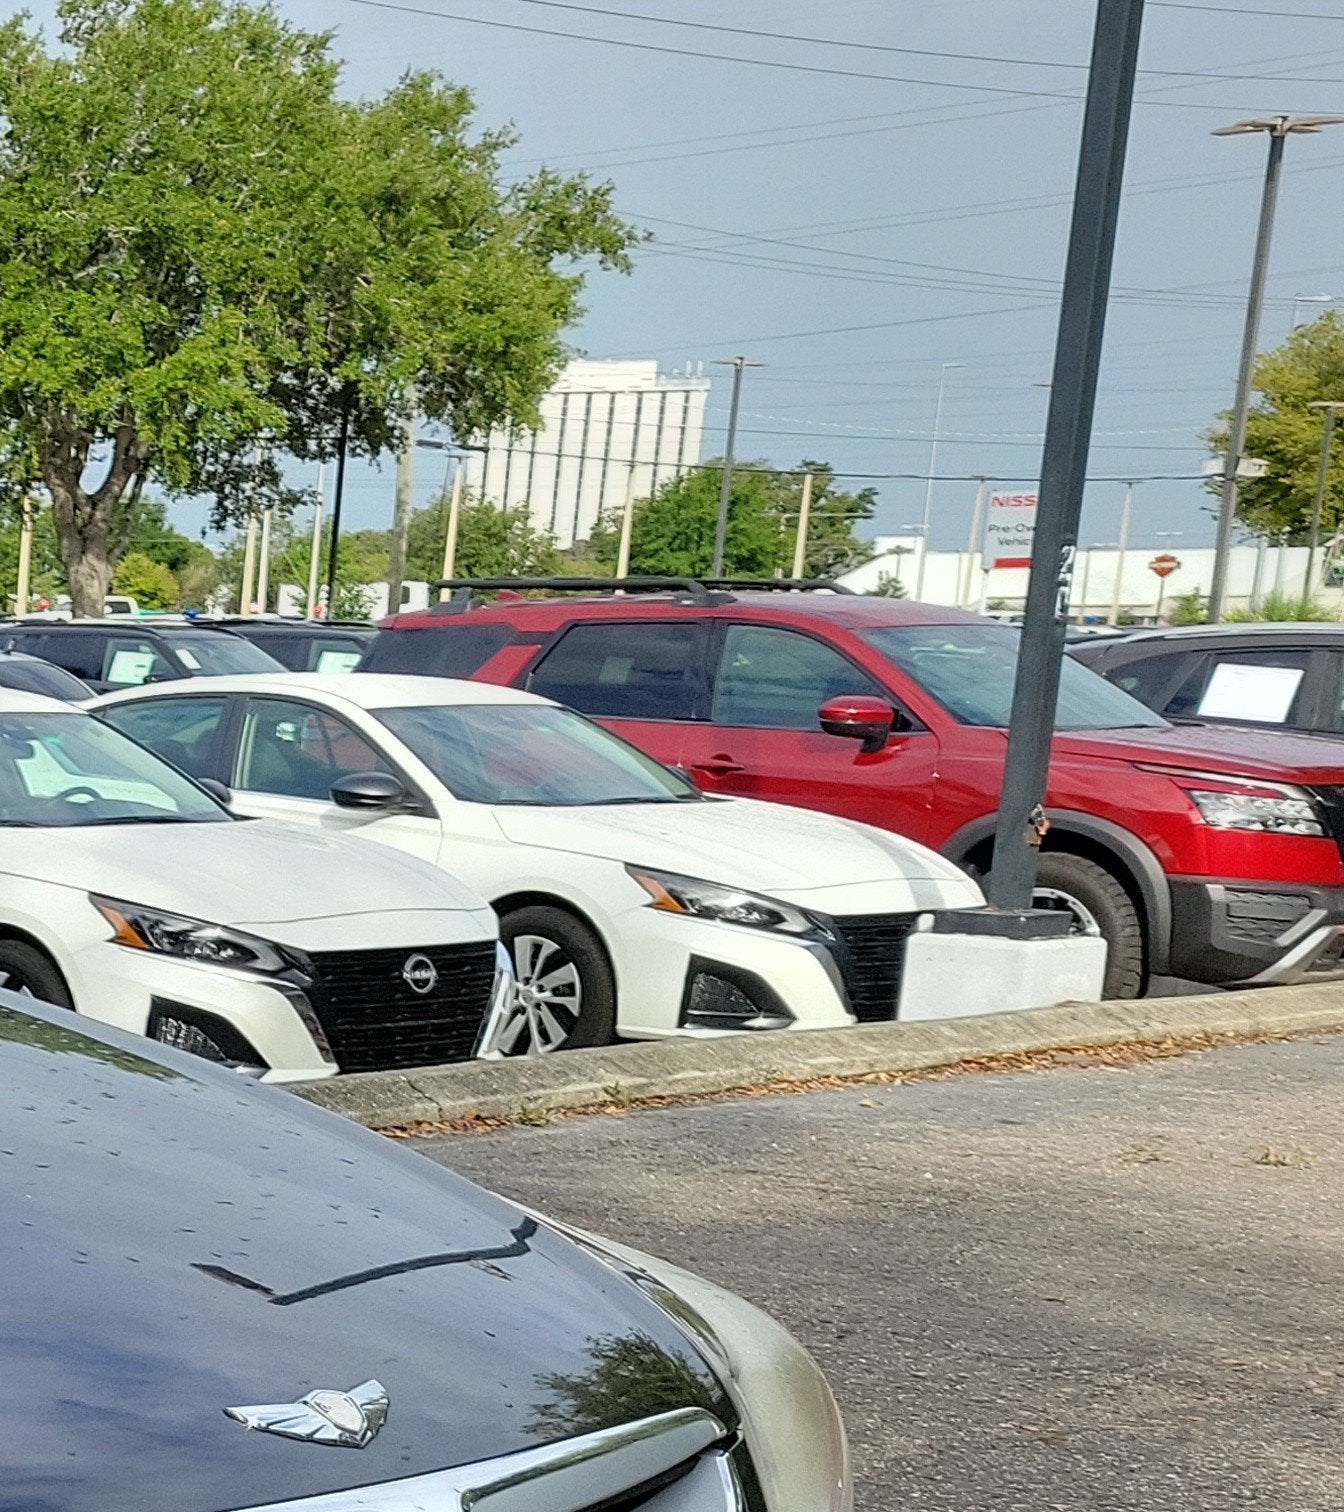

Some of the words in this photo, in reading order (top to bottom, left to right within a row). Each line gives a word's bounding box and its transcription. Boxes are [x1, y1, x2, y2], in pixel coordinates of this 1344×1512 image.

[991, 494, 1037, 507] NISS
[987, 522, 1037, 533] Pre-Ow
[997, 537, 1032, 546] Vehic
